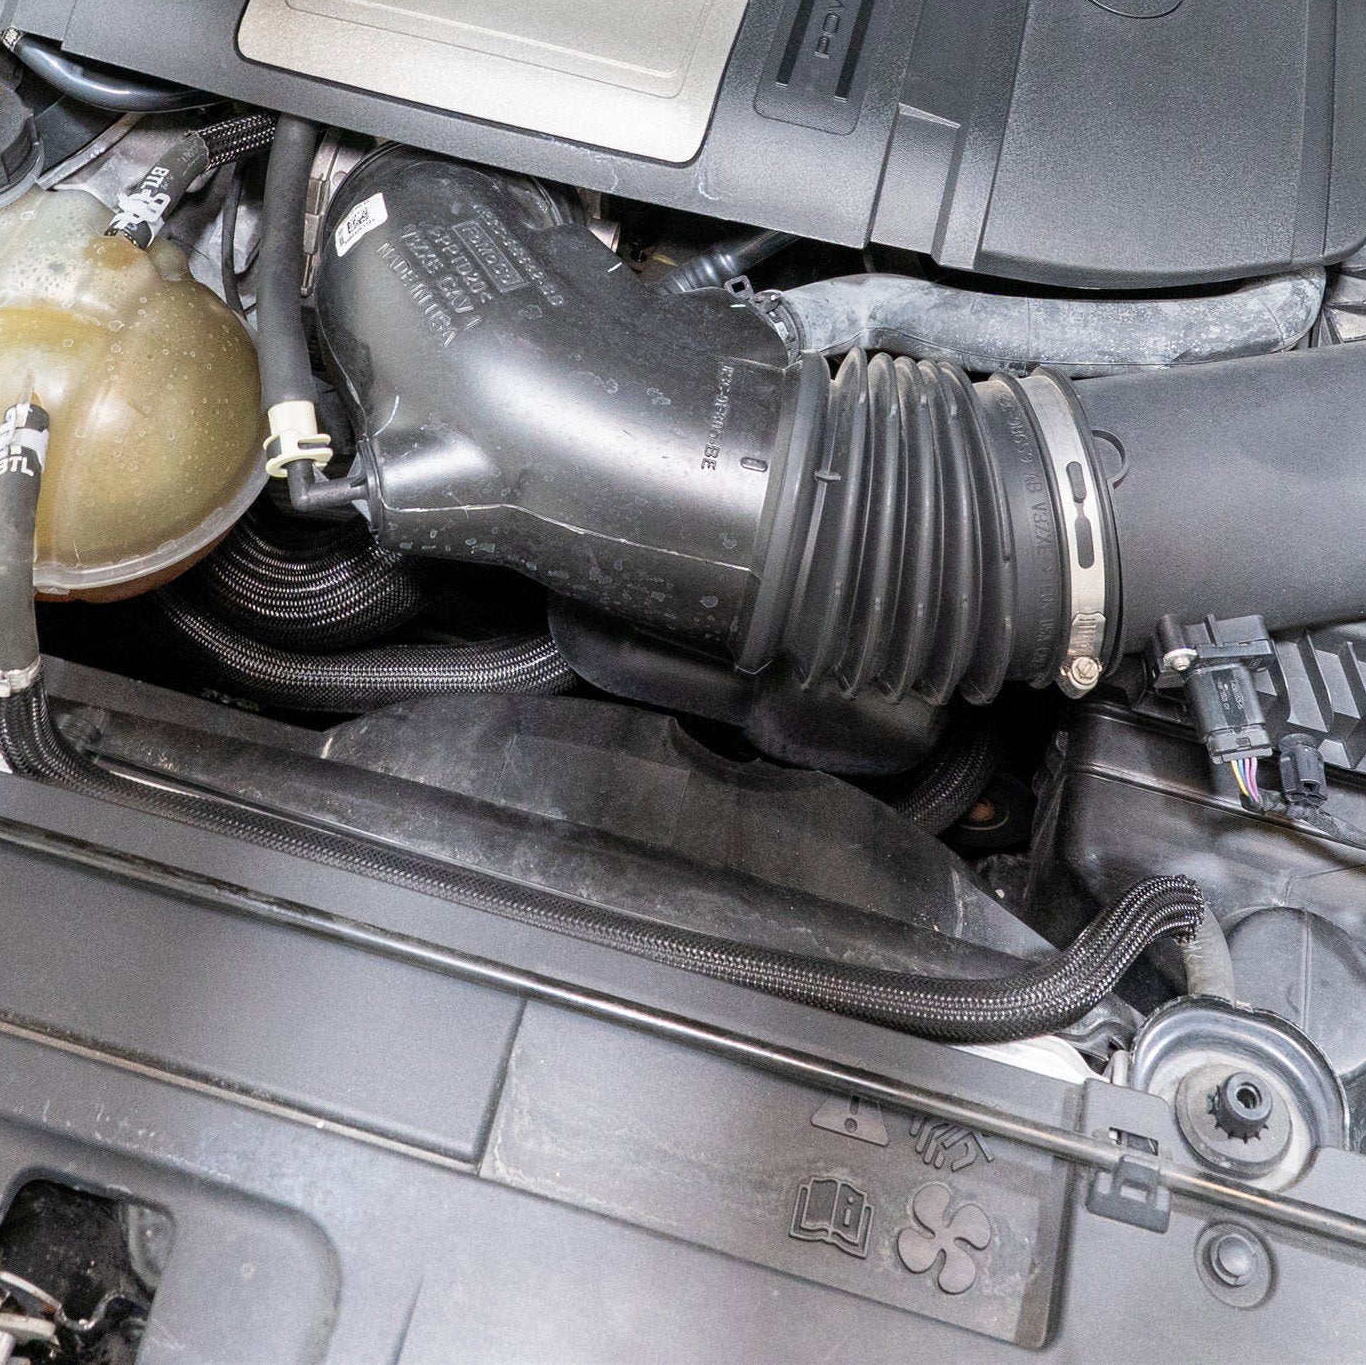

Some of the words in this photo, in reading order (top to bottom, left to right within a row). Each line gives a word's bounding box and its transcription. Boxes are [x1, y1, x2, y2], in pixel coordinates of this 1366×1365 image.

[376, 241, 418, 287] MADE
[409, 283, 434, 306] IN
[423, 302, 458, 349] USA
